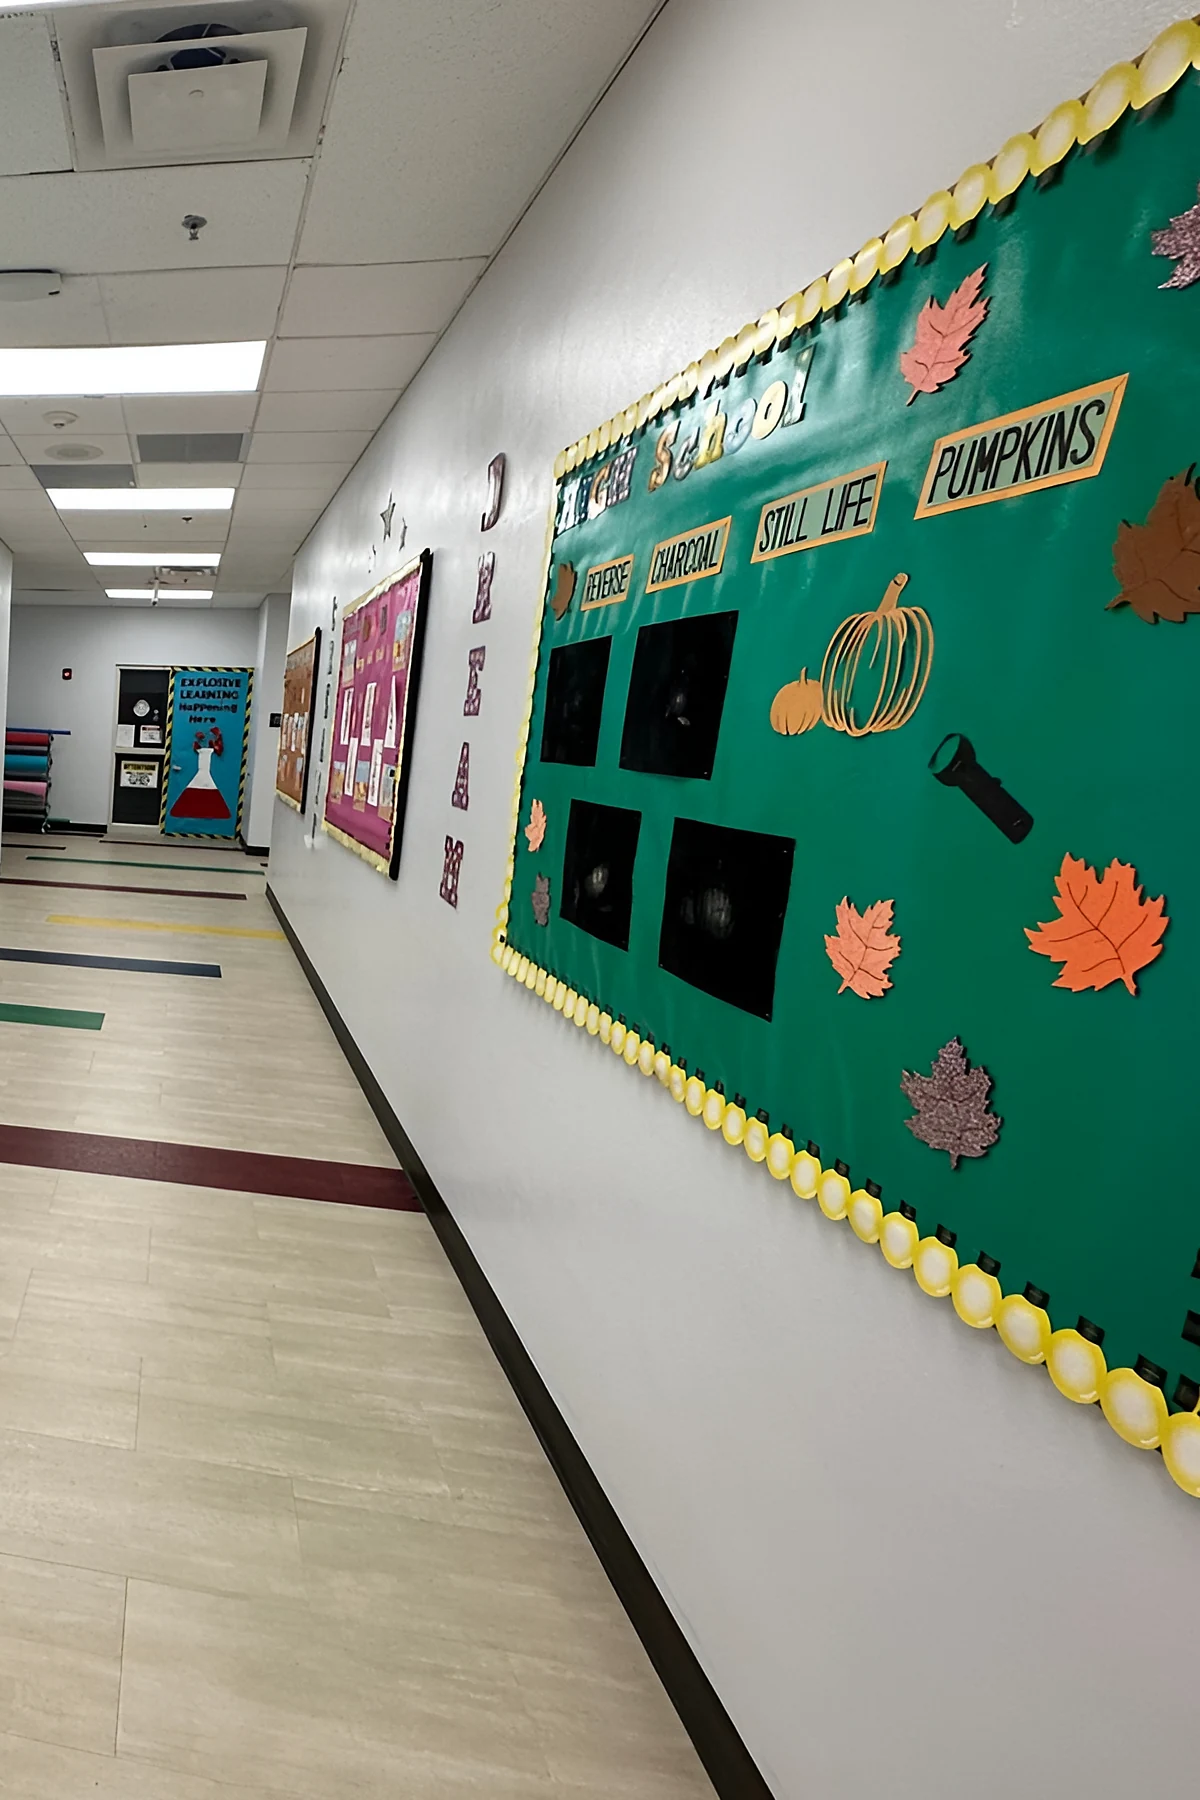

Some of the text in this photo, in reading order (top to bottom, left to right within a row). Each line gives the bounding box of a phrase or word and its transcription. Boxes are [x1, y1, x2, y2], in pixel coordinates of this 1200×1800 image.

[927, 399, 1105, 504] PUMPKINS
[759, 473, 877, 552] STILL LIFE
[650, 530, 719, 585] CHARCOAL
[180, 677, 241, 687] EXPLOSIVE
[180, 690, 239, 699] LEARNING
[179, 702, 237, 713] Happening
[189, 714, 216, 723] Here
